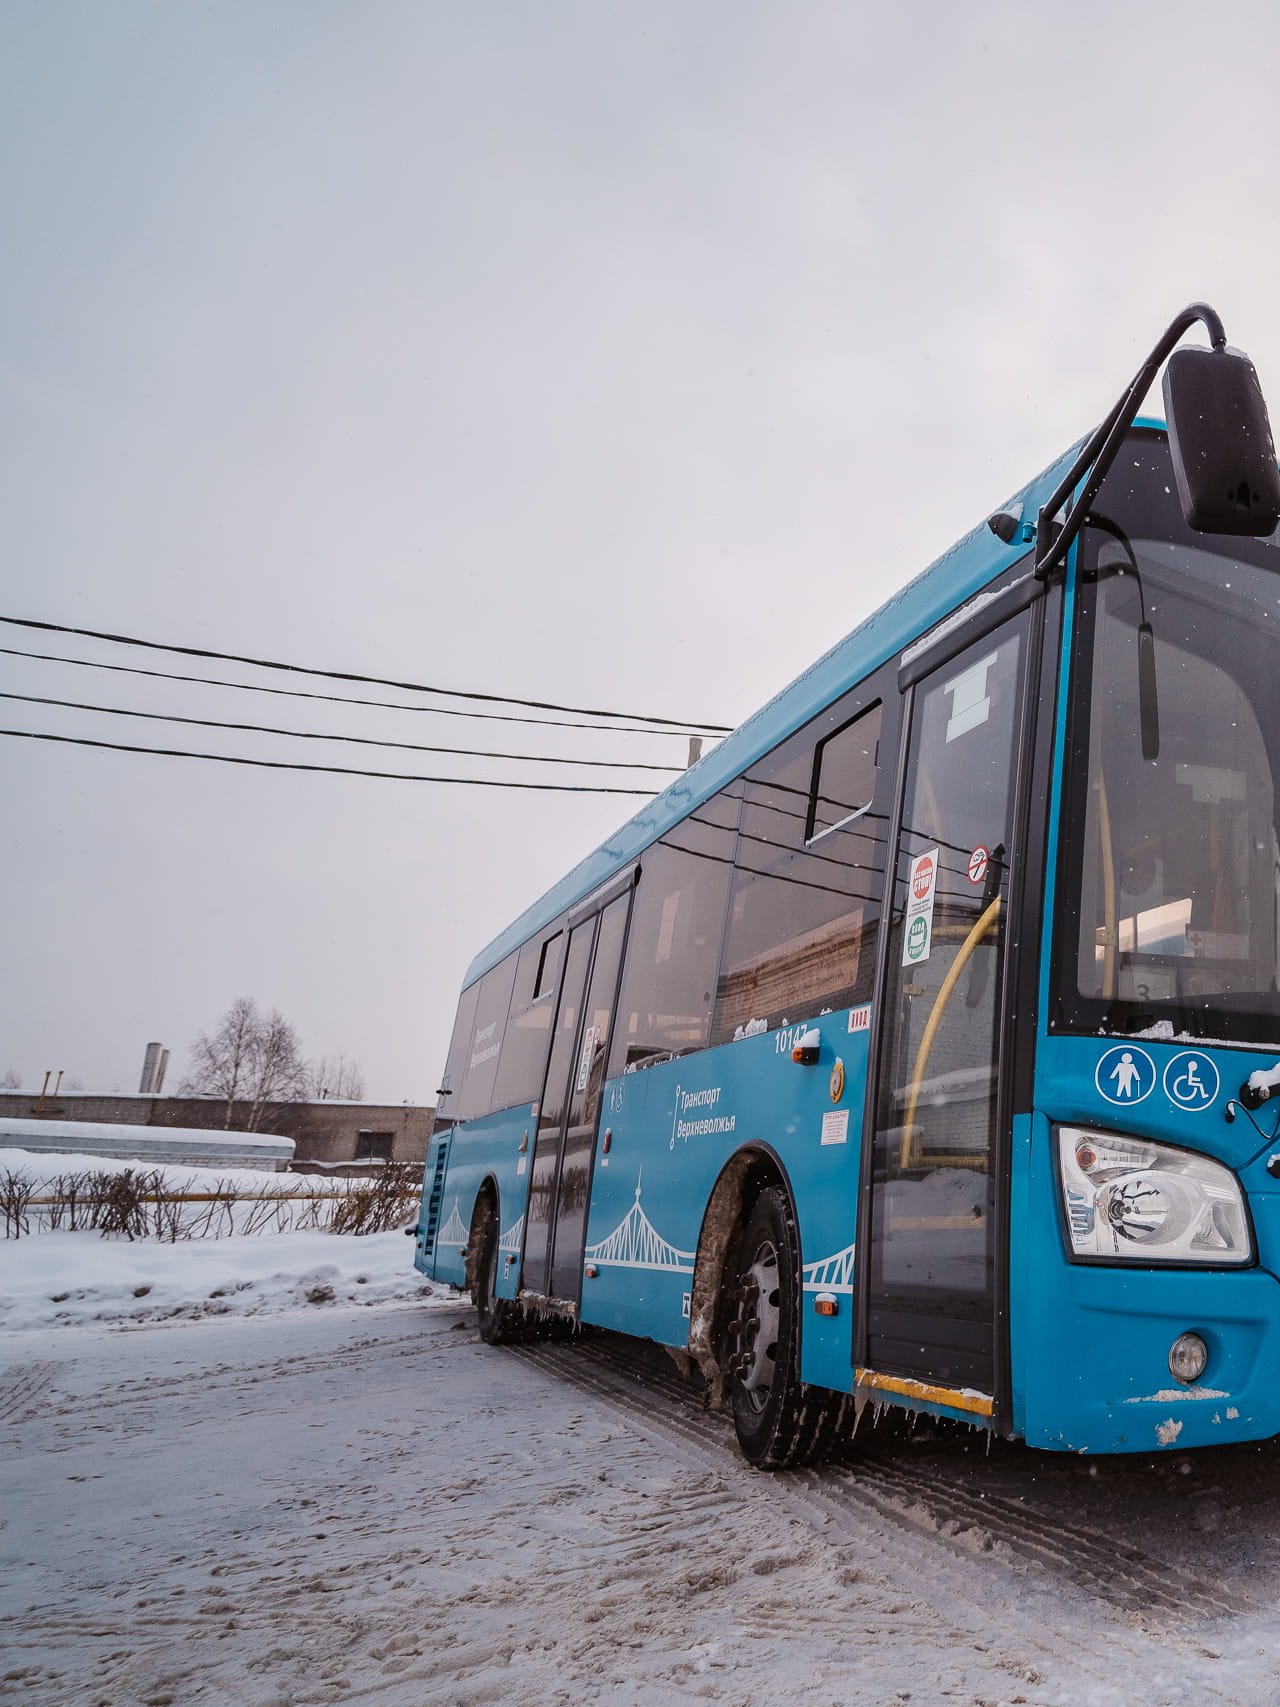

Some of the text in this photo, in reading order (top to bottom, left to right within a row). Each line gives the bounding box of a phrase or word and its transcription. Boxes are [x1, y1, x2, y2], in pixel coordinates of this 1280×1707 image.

[851, 1010, 868, 1028] ВХОД
[681, 1087, 721, 1115] Транспорт
[677, 1115, 736, 1143] Верхневолжья
